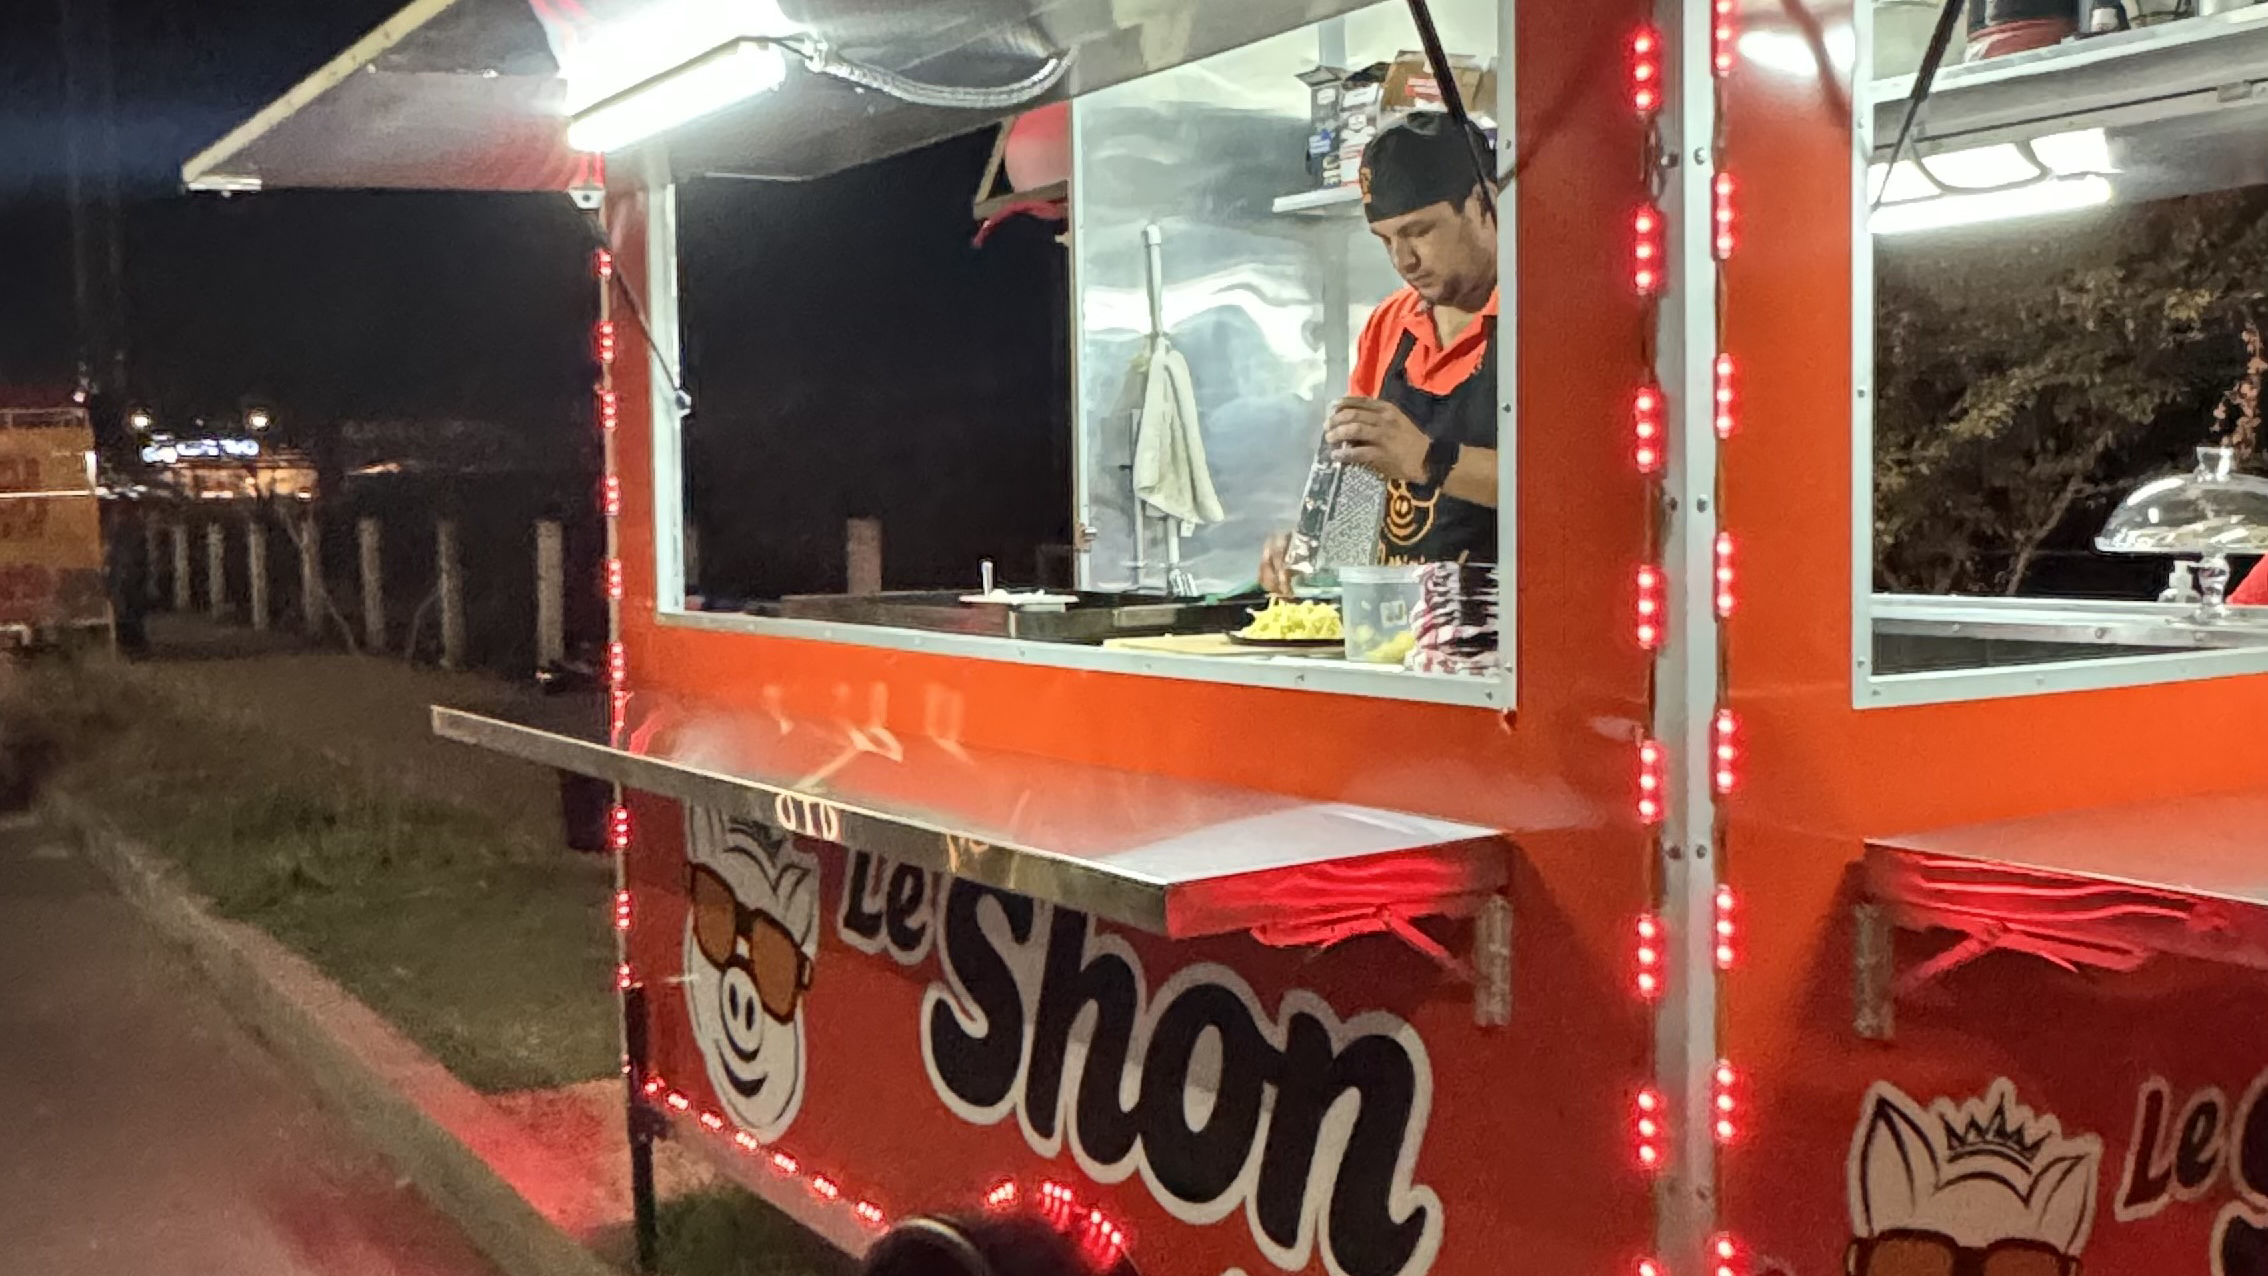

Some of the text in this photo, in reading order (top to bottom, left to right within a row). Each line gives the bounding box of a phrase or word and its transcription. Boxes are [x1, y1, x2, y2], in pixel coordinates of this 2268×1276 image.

[839, 851, 1443, 1276] Le Shon
[2115, 1077, 2225, 1221] Le
